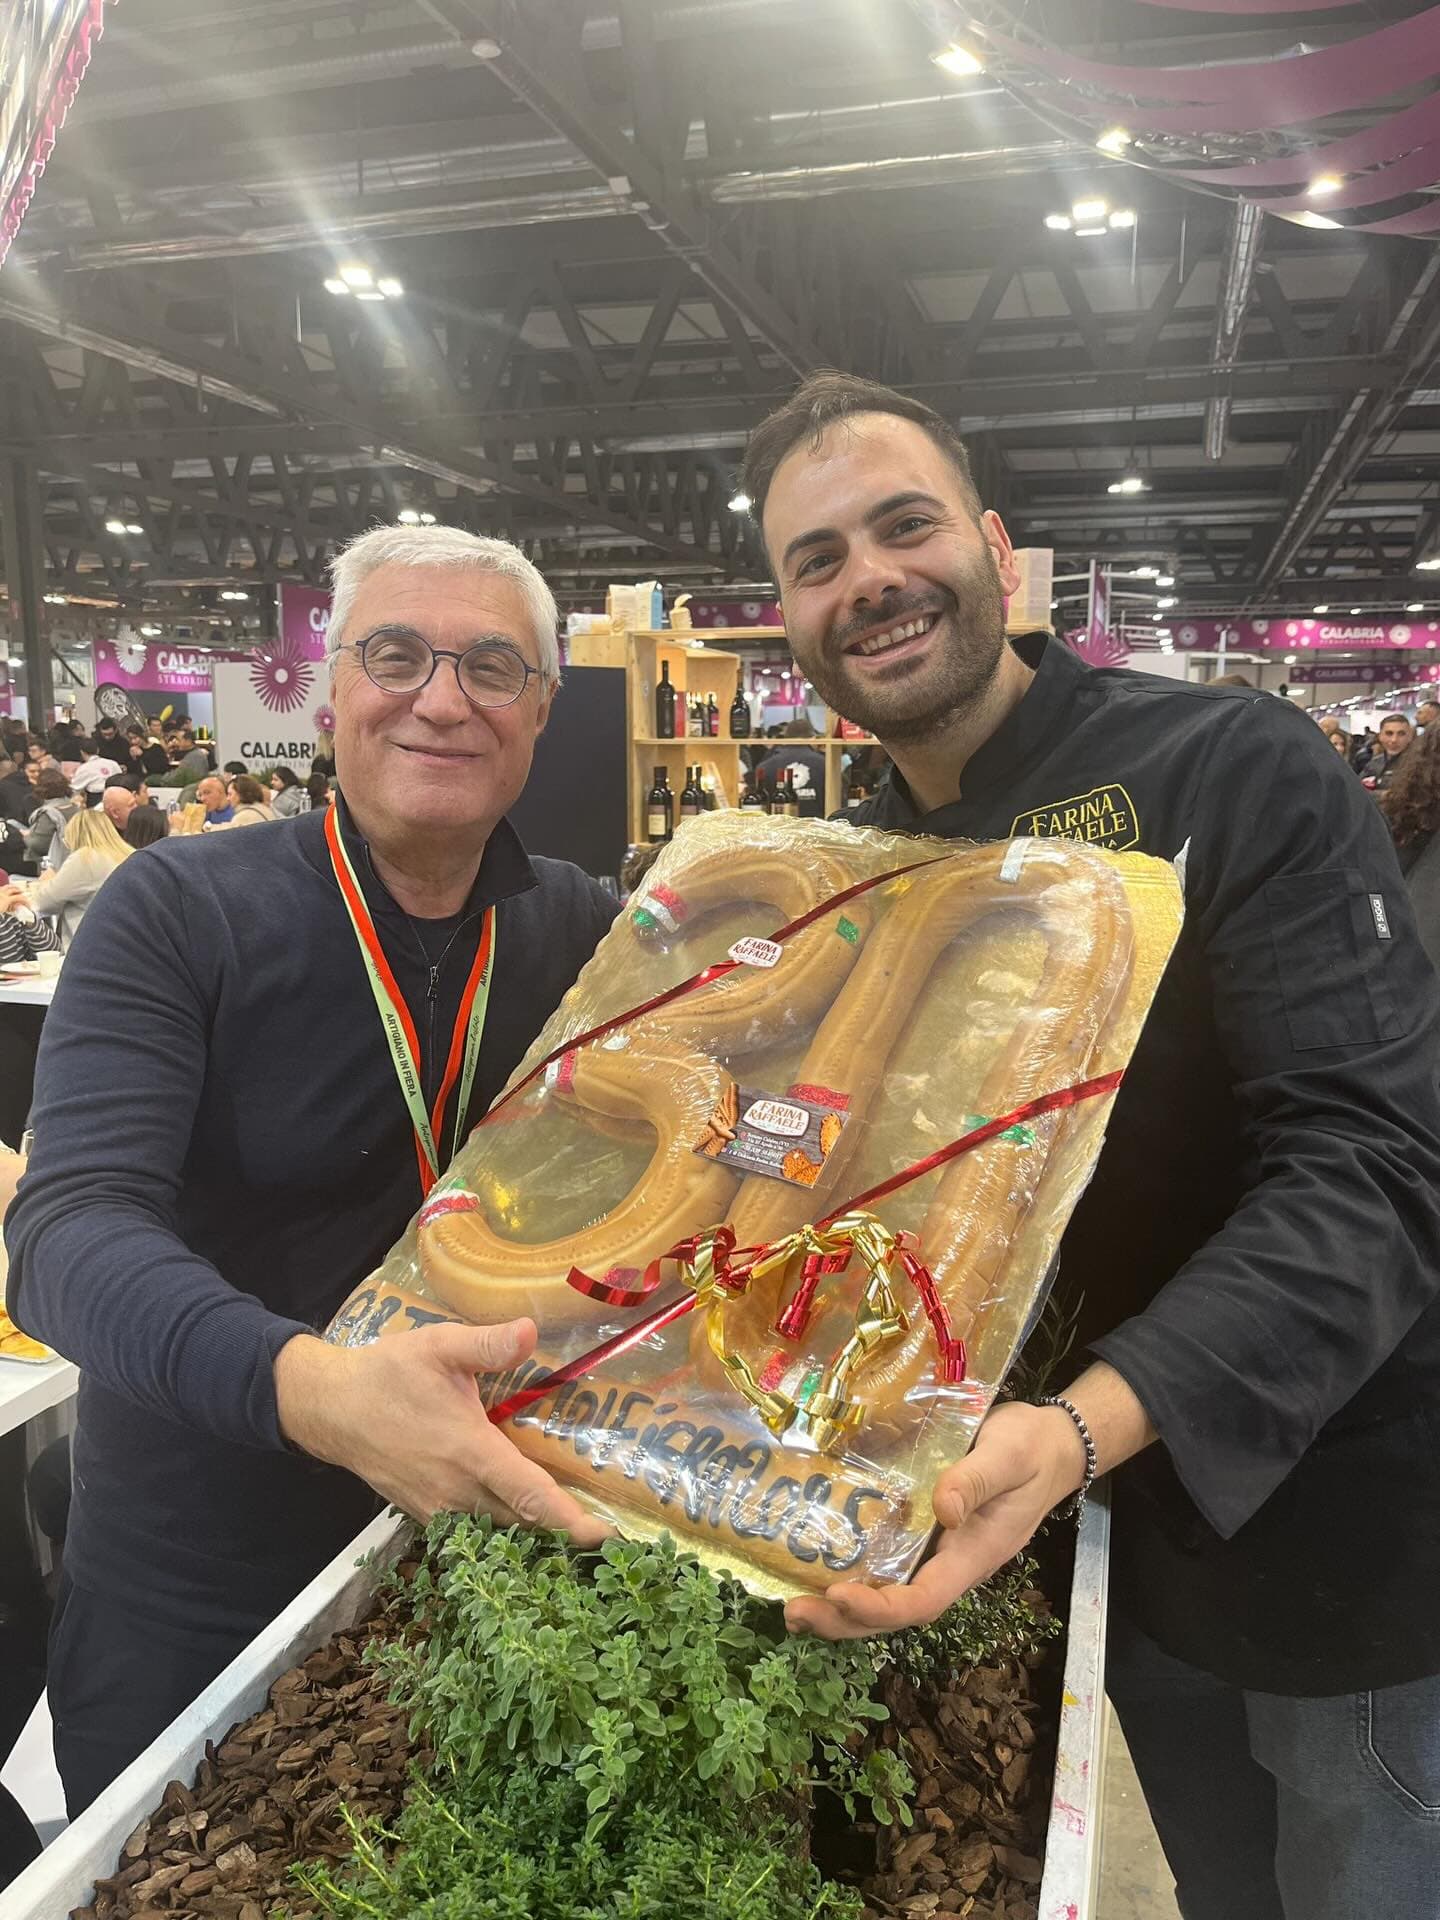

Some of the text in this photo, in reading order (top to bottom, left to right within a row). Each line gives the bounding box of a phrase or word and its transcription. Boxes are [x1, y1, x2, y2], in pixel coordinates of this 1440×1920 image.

[1320, 626, 1385, 639] CALABRIA
[156, 651, 230, 676] CALABR
[240, 742, 317, 759] CALABRI
[1028, 793, 1115, 838] FARINA
[733, 944, 777, 962] RAFFAELE
[744, 938, 778, 955] FARINA
[386, 1013, 417, 1098] ARTIGIANO IN FIERA
[749, 1109, 805, 1129] RAFFAELE
[760, 1101, 803, 1121] FARINA
